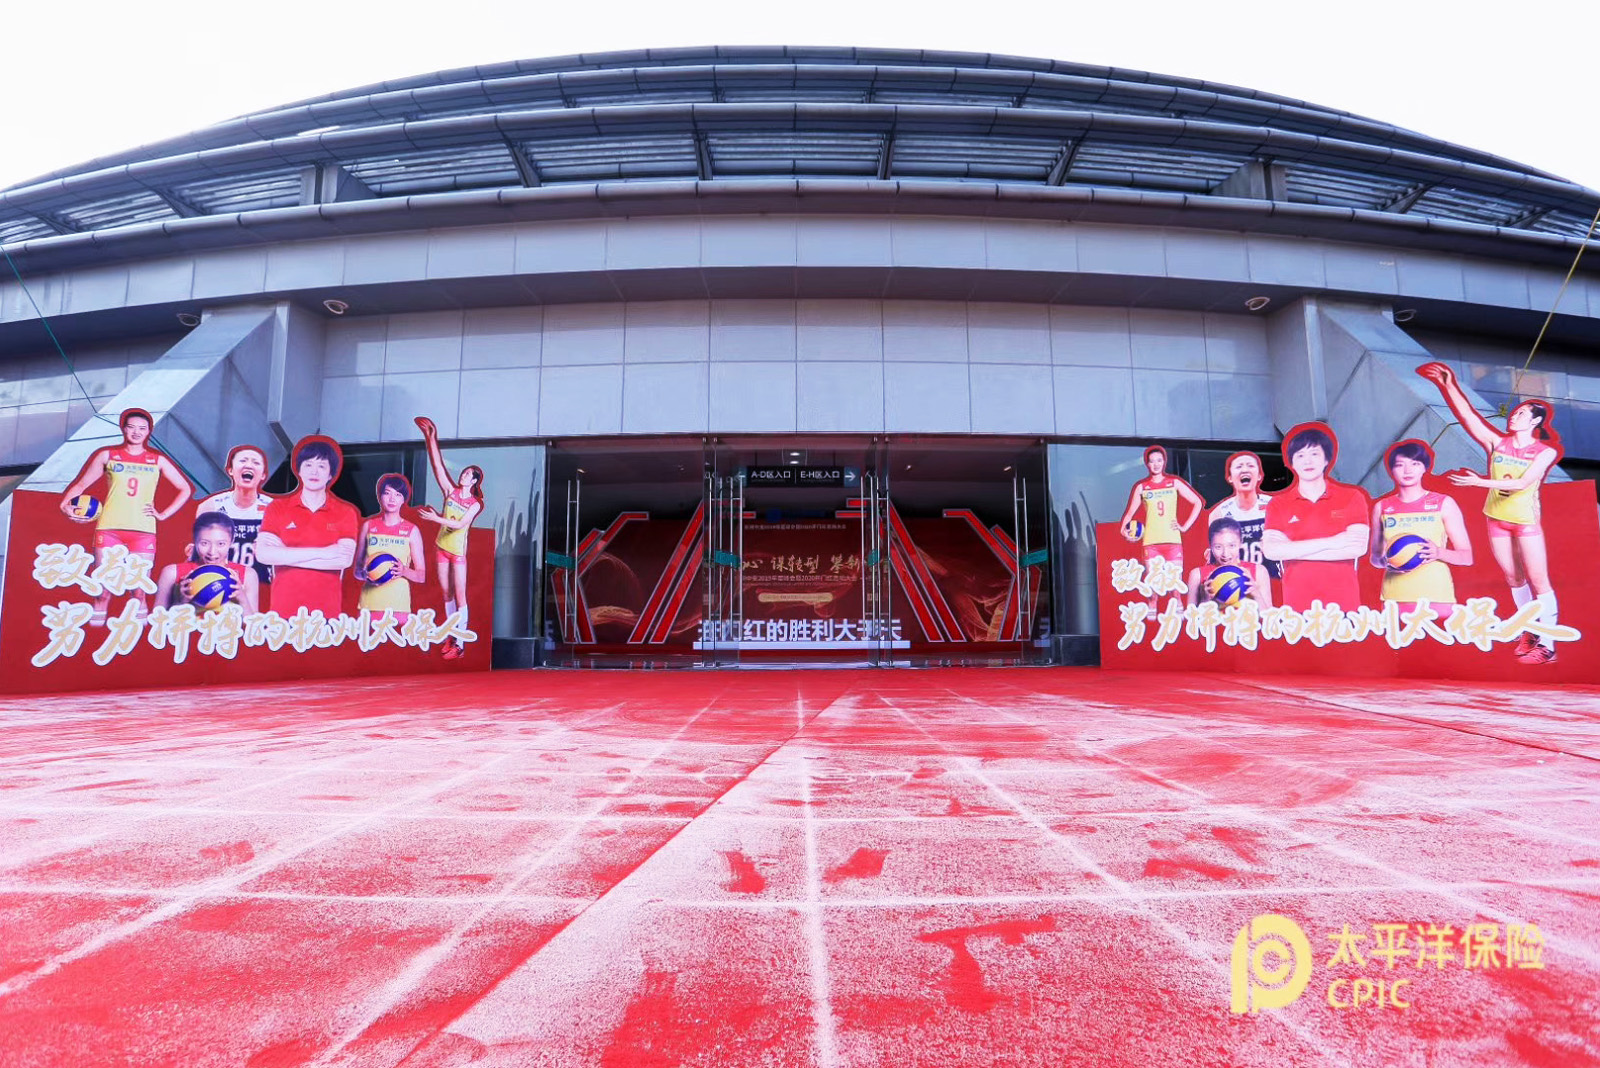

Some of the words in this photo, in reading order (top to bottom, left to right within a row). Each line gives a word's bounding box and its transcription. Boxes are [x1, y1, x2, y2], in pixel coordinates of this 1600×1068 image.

[127, 477, 138, 497] 9
[1157, 501, 1165, 517] 9
[33, 543, 158, 596] 致敬
[1111, 555, 1188, 596] 致敬
